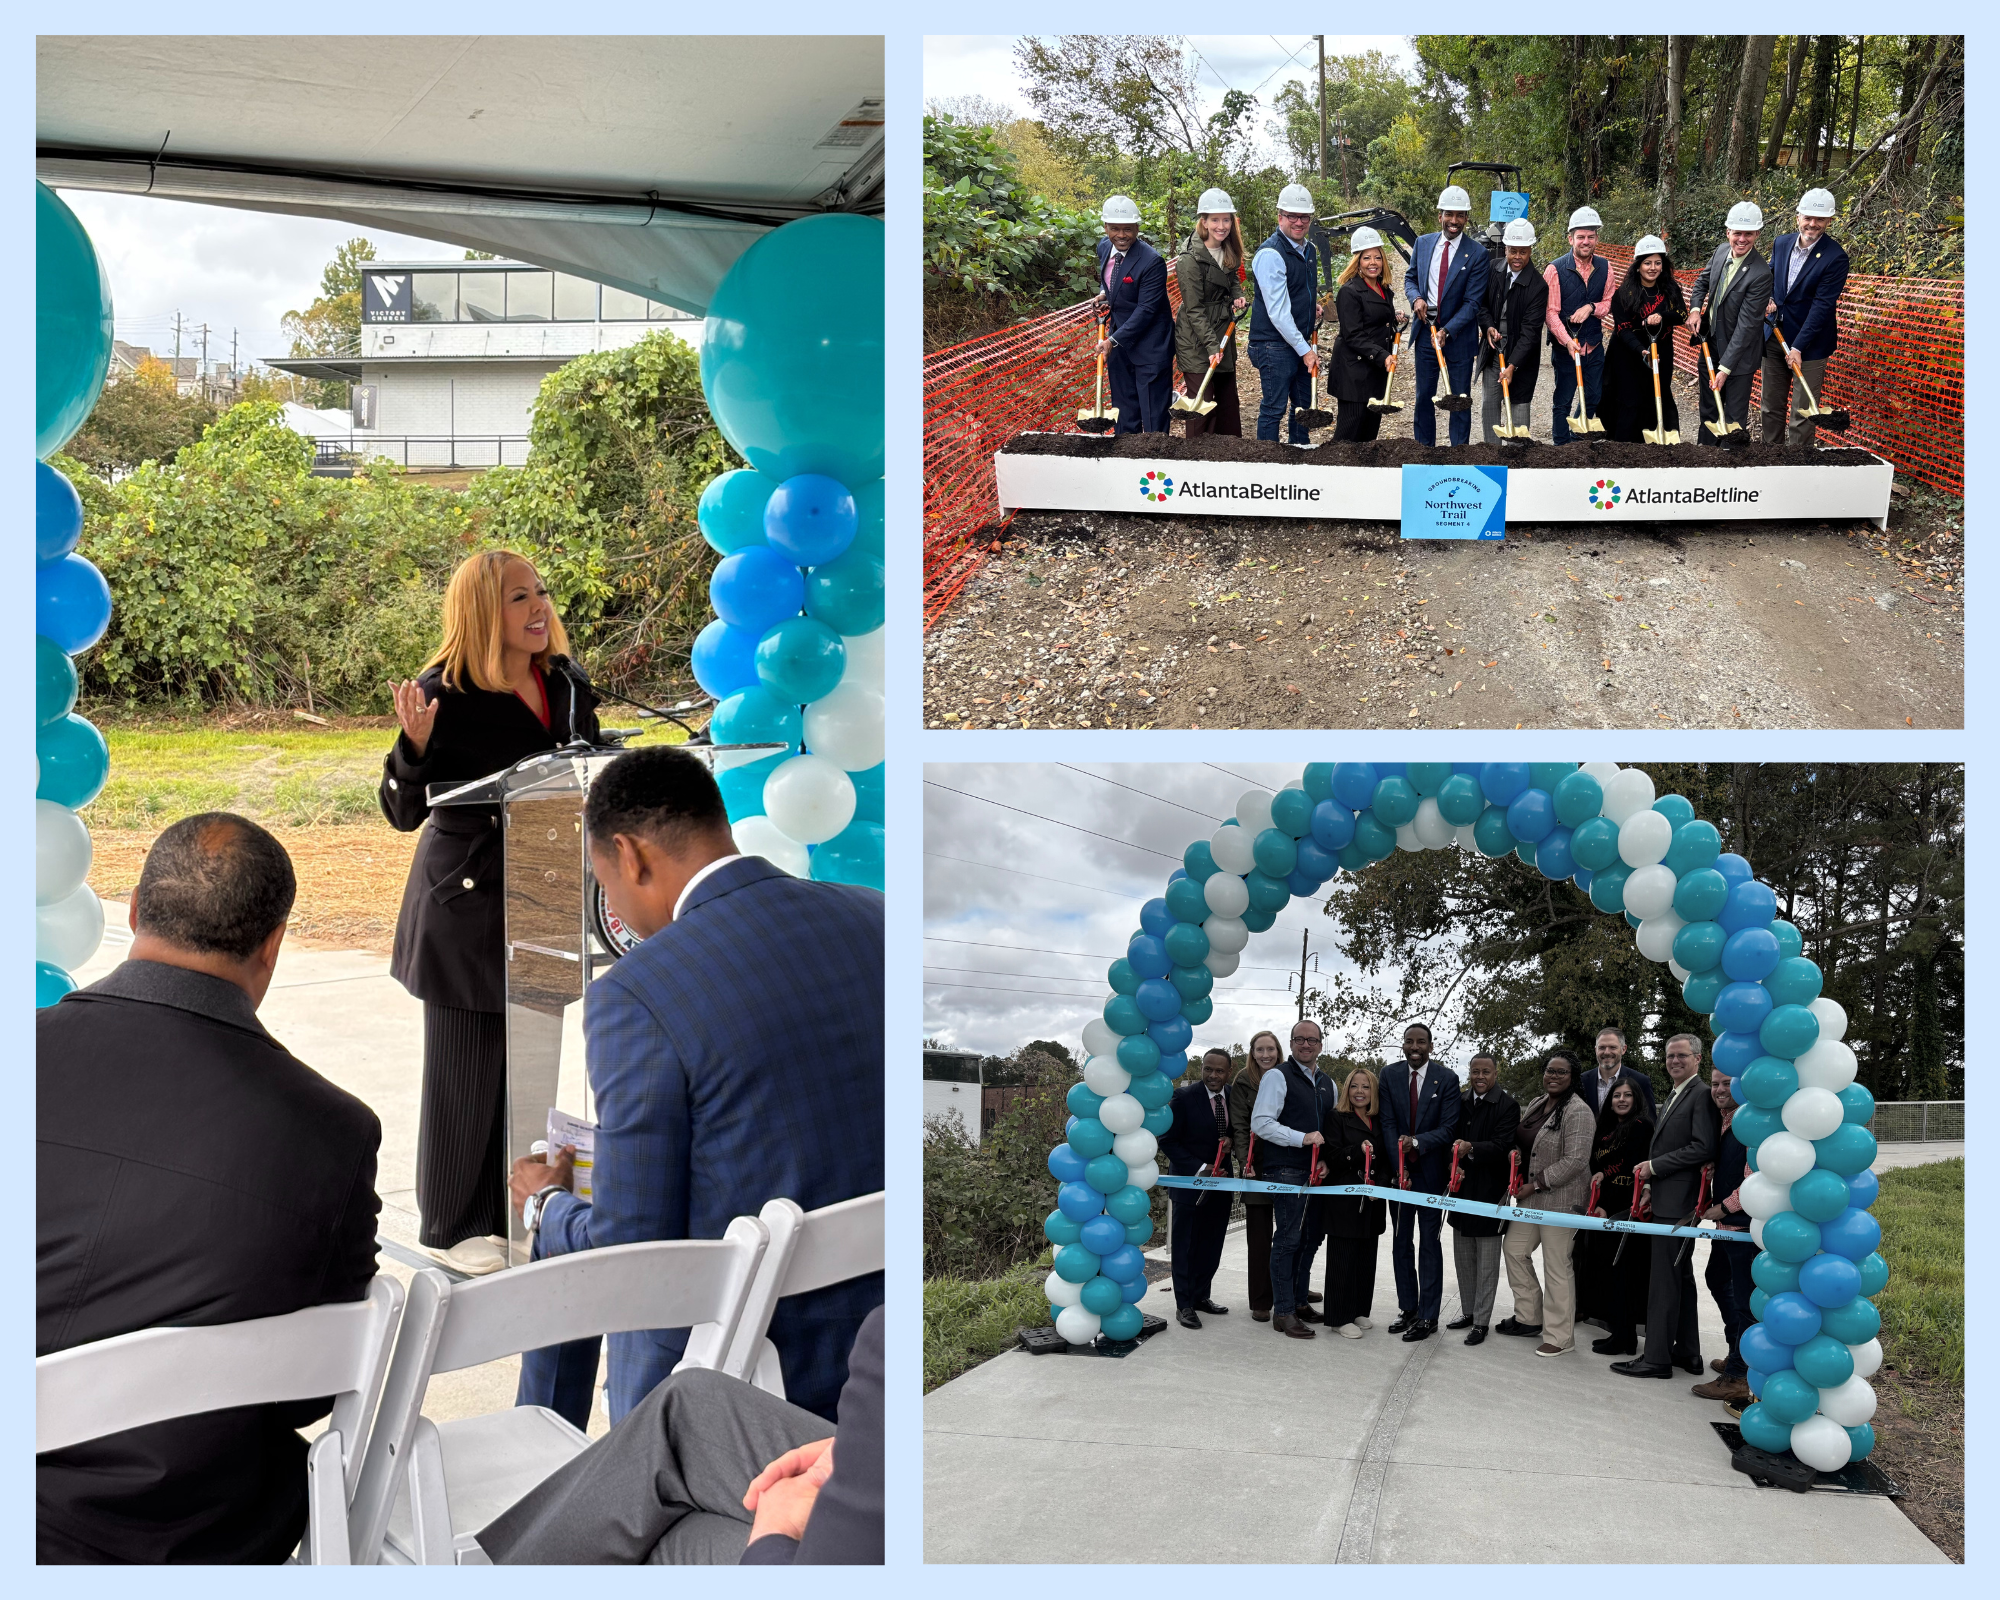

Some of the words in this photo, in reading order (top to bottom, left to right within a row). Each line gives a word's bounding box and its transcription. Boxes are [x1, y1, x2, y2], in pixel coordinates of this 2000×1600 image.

[1178, 481, 1320, 500] AtlantaBeltline
[1428, 478, 1481, 493] GROUNDBREAKING
[1625, 487, 1760, 504] AtlantaBeltline
[1424, 500, 1482, 510] Northwest
[1440, 510, 1466, 519] Trail
